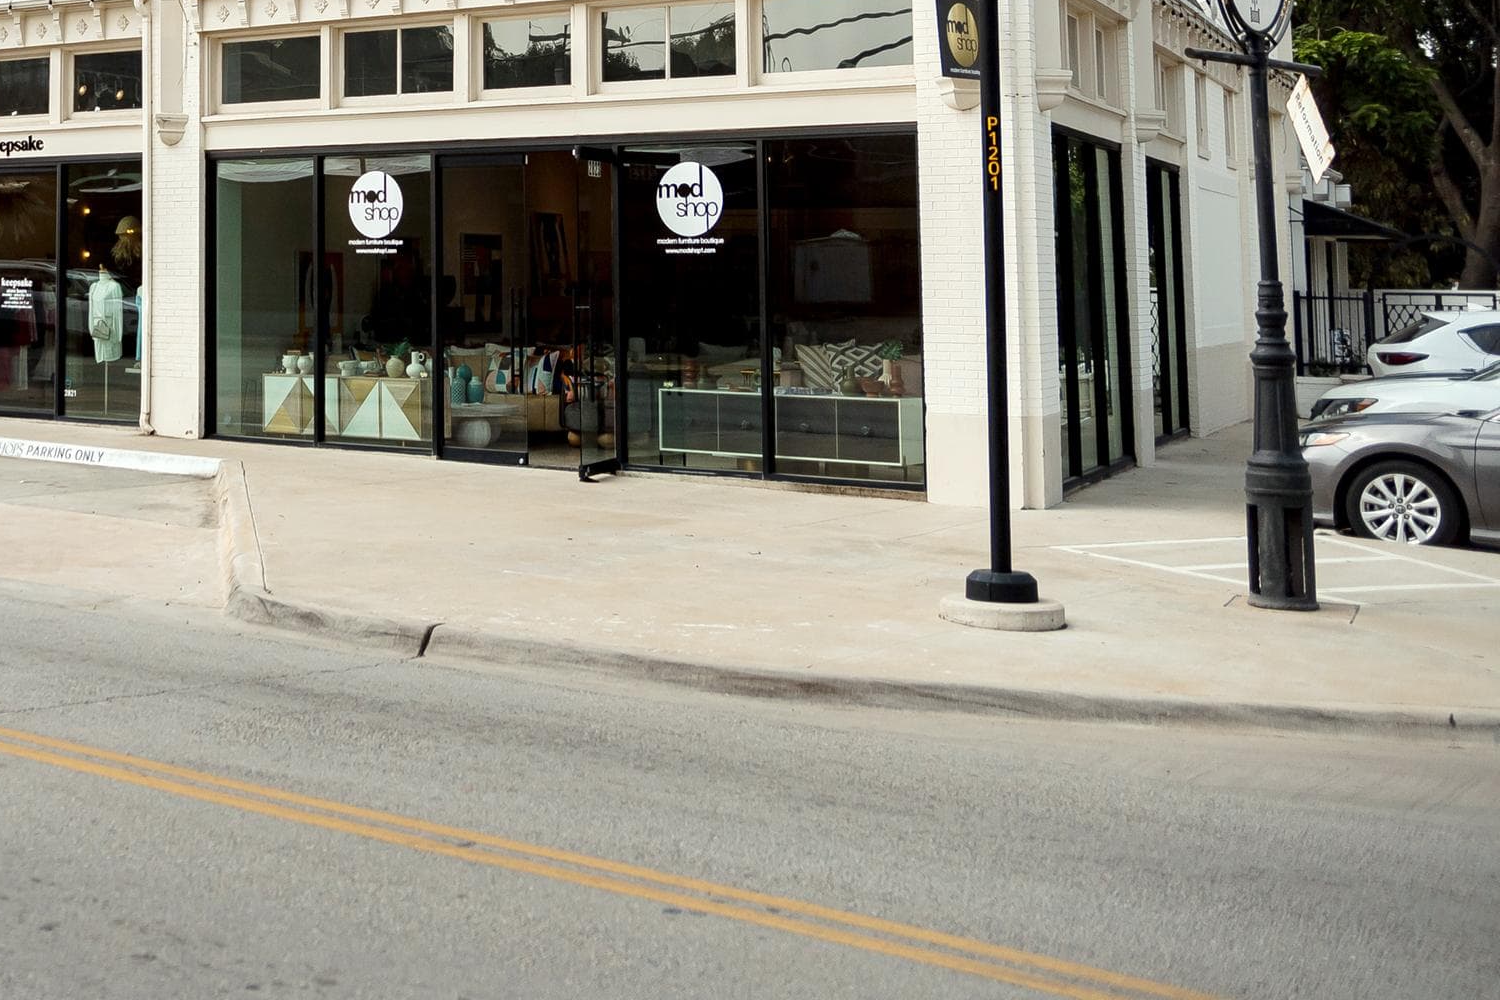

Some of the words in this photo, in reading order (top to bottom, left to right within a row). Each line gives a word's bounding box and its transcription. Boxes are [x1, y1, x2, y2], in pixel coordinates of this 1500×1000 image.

[947, 7, 969, 34] mod
[957, 34, 977, 62] shop
[1295, 92, 1324, 164] Reformation
[987, 117, 1001, 191] P1201
[349, 172, 387, 204] mod
[658, 164, 703, 198] mod
[364, 203, 399, 233] shop
[676, 197, 718, 231] shop
[700, 237, 725, 246] boutique
[1, 277, 33, 289] keepsake
[26, 444, 72, 460] PARKING
[74, 449, 104, 463] ONLY
